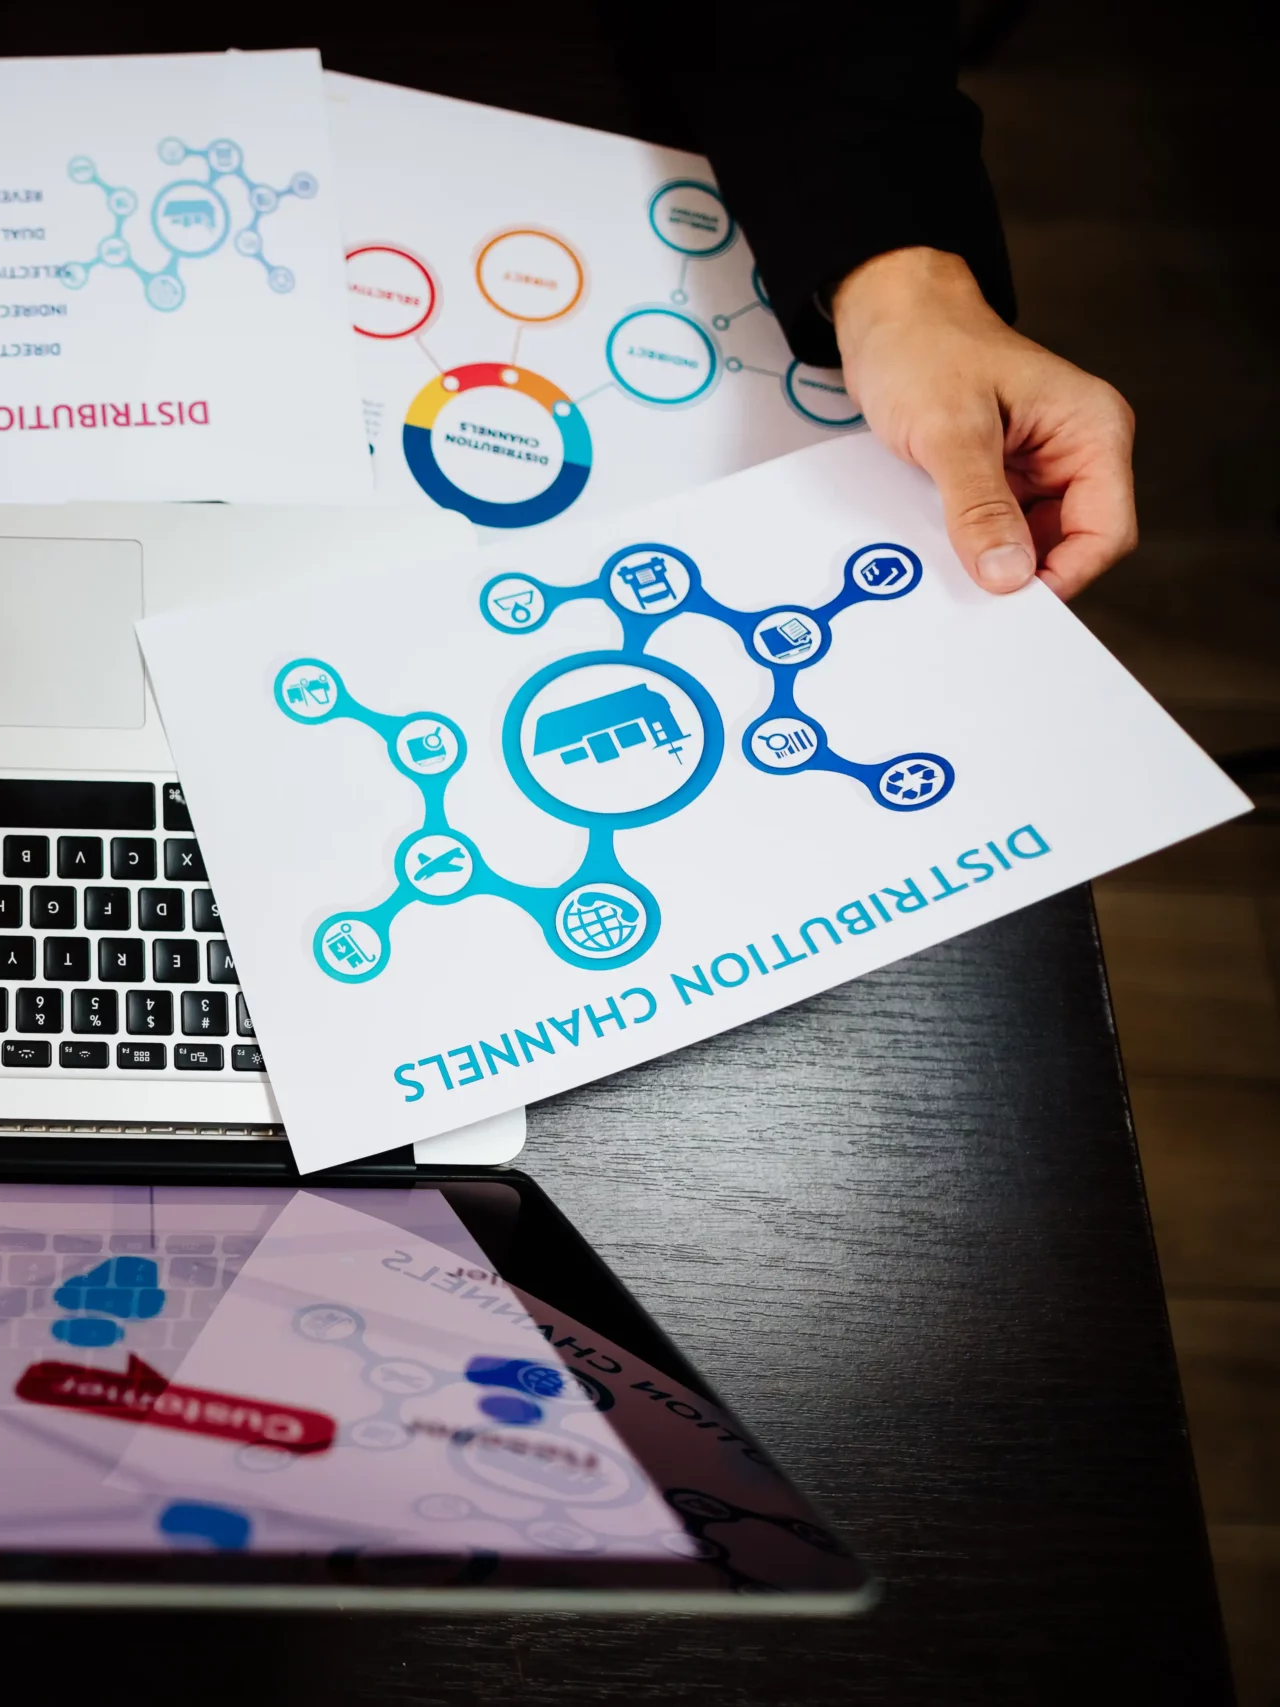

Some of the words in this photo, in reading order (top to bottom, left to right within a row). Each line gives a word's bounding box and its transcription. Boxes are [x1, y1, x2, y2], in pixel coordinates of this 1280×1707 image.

[1, 228, 46, 241] DUAL
[0, 343, 61, 357] DIRECT
[460, 422, 540, 448] CHANNELS
[445, 434, 548, 466] DISTRIBUTION
[22, 850, 30, 862] B
[76, 851, 85, 863] V
[129, 852, 138, 864] C
[182, 853, 192, 865] X
[48, 901, 59, 913] G
[104, 903, 111, 914] F
[157, 903, 167, 915] D
[211, 904, 220, 917] S
[670, 822, 1053, 1006] DISTRIBUTION
[8, 952, 17, 964] Y
[64, 953, 72, 965] T
[118, 954, 126, 966] R
[173, 955, 180, 967] E
[36, 996, 44, 1008] 6
[92, 998, 99, 1009] 5
[146, 999, 155, 1010] 4
[201, 999, 209, 1011] 3
[36, 1014, 45, 1025] &
[90, 1015, 101, 1026] %
[147, 1016, 154, 1028] $
[202, 1017, 210, 1028] #
[244, 1019, 253, 1029] @
[5, 1043, 15, 1052] F6
[392, 986, 656, 1103] CHANNELS
[60, 1378, 304, 1443] Customer
